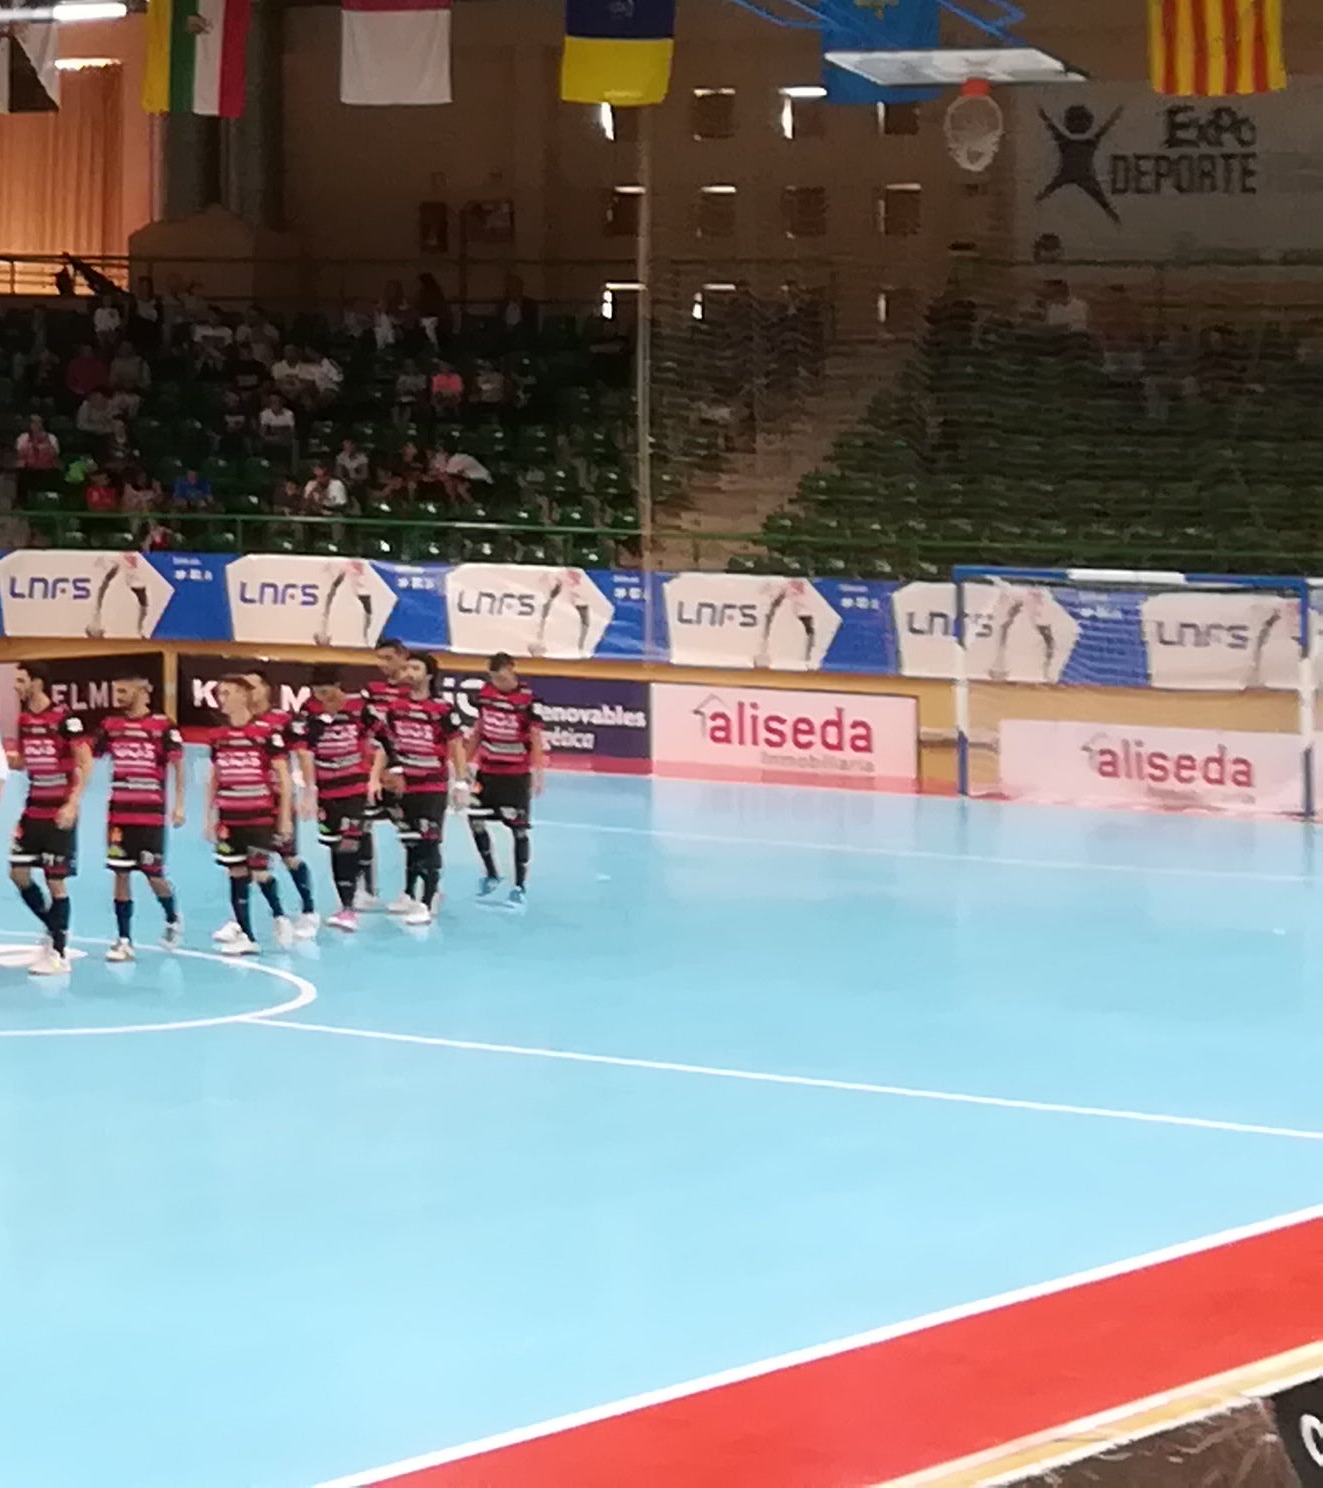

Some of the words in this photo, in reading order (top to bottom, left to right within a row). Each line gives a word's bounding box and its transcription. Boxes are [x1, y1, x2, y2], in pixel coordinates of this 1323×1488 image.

[1111, 152, 1257, 194] DEPORTE
[9, 575, 92, 601] LNFS
[240, 580, 319, 607] LNFS
[458, 590, 536, 617] LNFS
[677, 600, 758, 628] LNFS
[1158, 621, 1250, 649] LNFS
[709, 701, 873, 753] aliseda
[1098, 738, 1254, 788] aliseda
